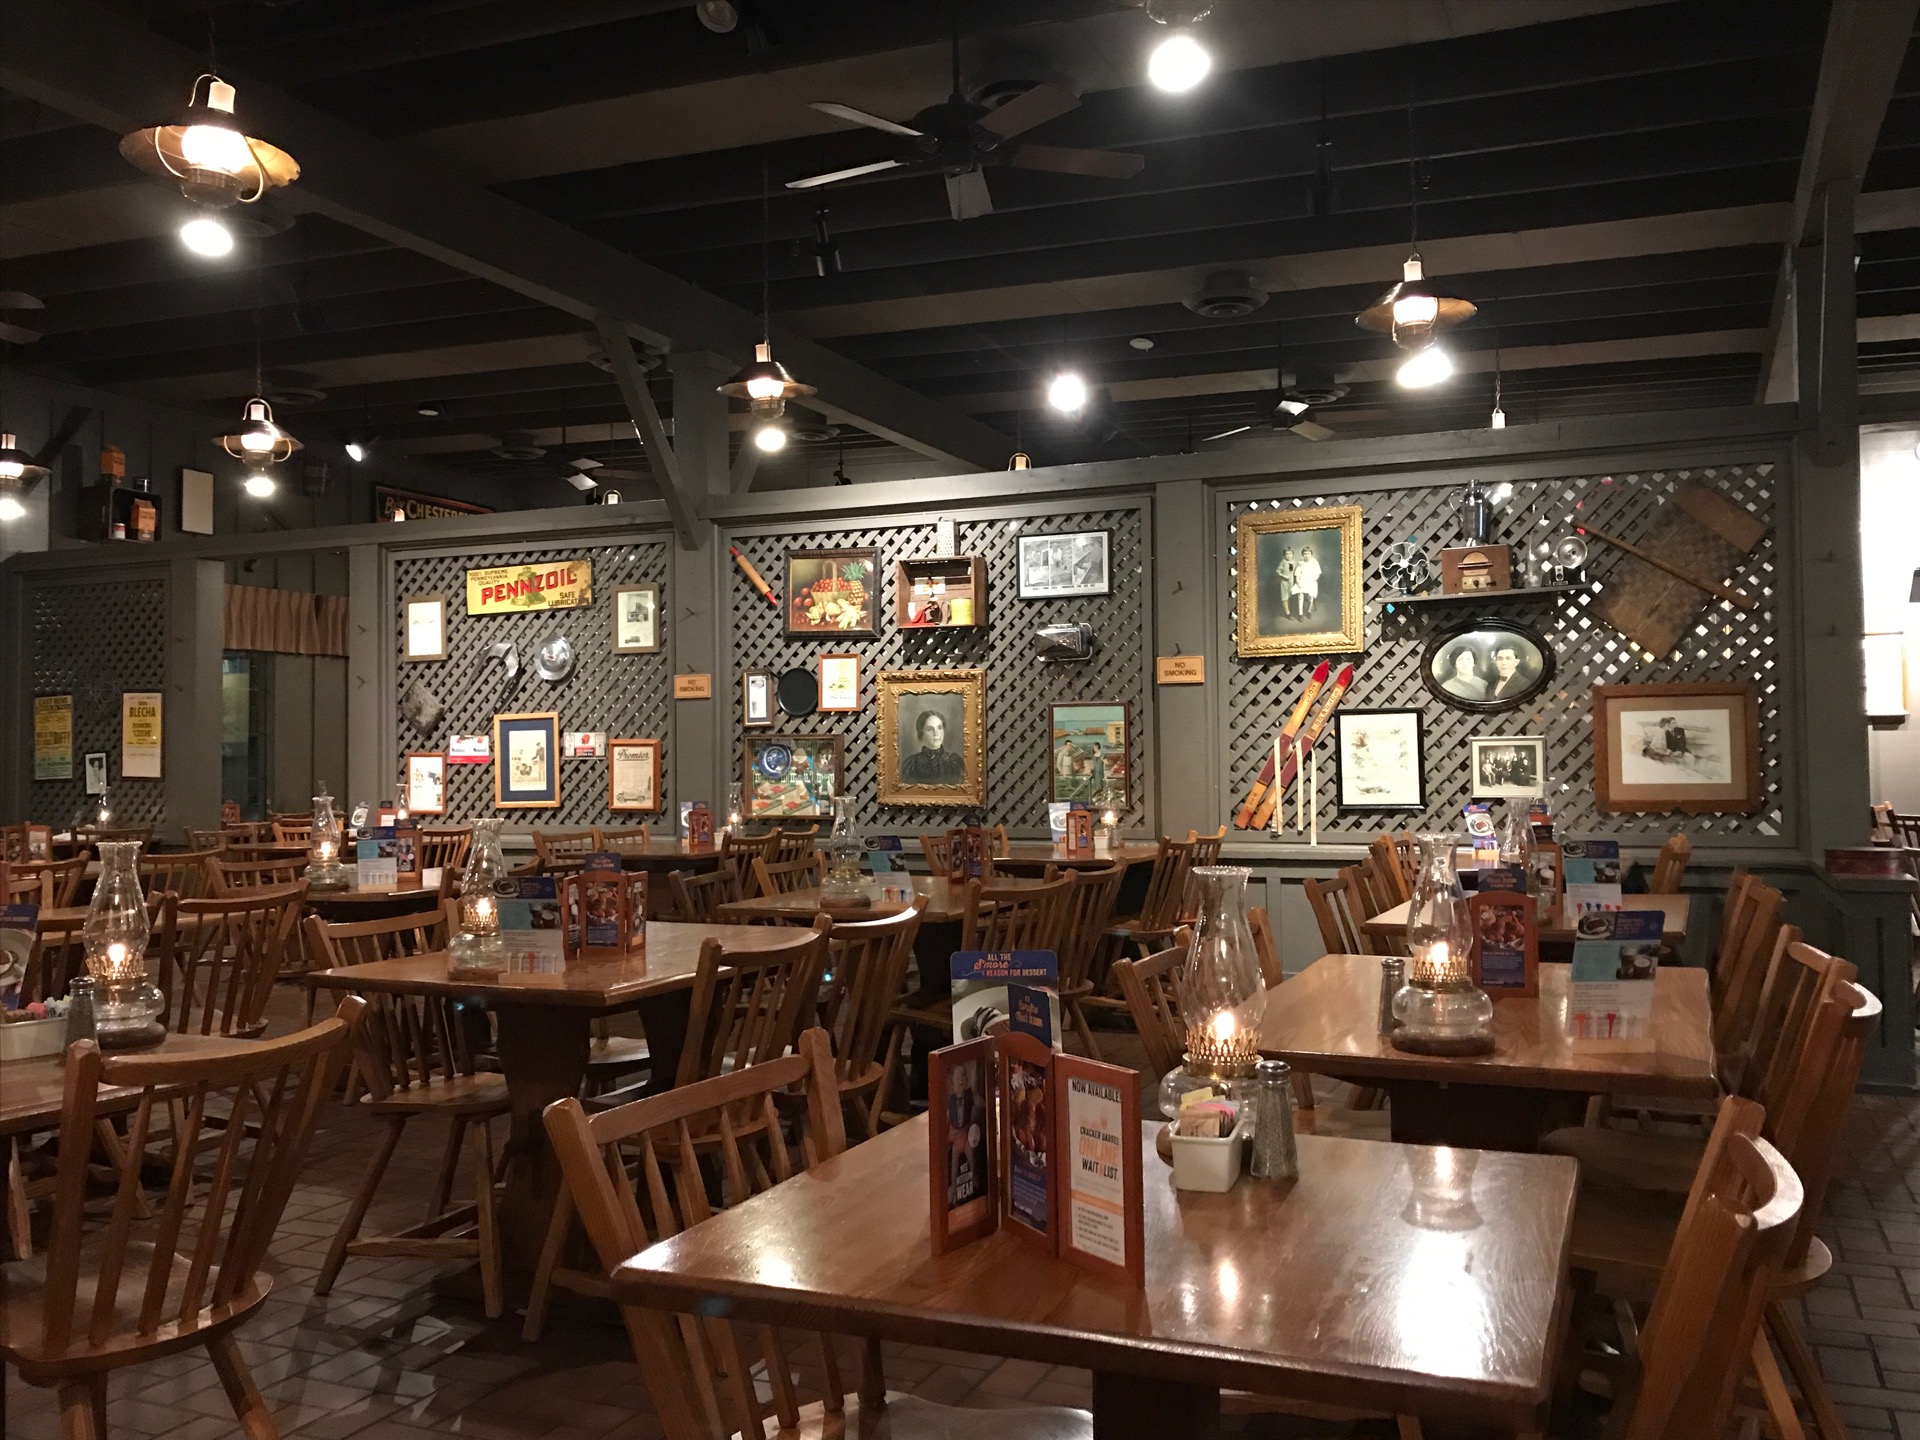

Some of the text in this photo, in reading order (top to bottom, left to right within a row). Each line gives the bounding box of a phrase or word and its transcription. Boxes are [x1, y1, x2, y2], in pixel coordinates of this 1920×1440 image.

[481, 567, 578, 606] PENNZOIL
[559, 591, 576, 599] SAFE
[1164, 669, 1197, 677] SMOKING
[129, 706, 156, 717] BLECHA
[987, 953, 1012, 961] ALL THE
[1010, 969, 1021, 977] FOR
[1022, 968, 1047, 977] DESSERT
[1072, 1080, 1086, 1094] NOW
[1080, 1126, 1101, 1140] CRACKER
[1082, 1158, 1099, 1174] WAIT
[956, 1181, 974, 1201] WEAR
